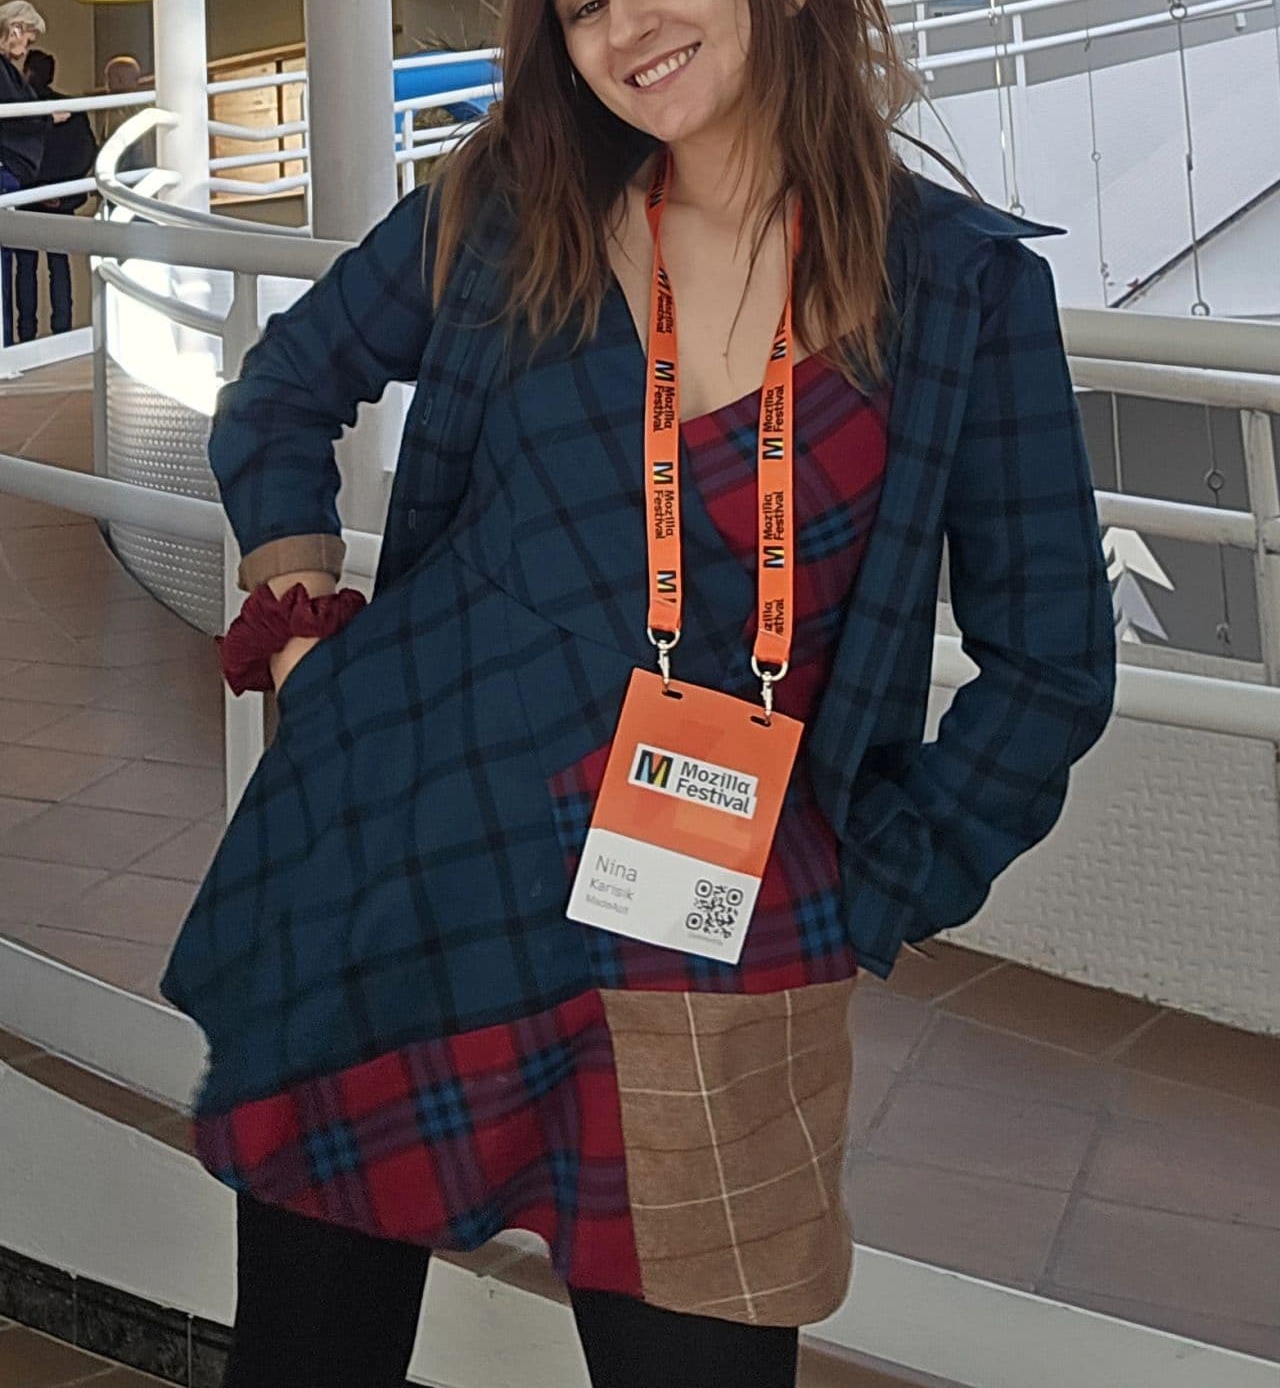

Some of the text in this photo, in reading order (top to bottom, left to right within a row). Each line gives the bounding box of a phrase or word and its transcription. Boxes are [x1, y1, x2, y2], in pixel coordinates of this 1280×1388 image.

[653, 385, 664, 432] Festival
[664, 387, 675, 428] Mozilla
[763, 389, 774, 432] Mozilla
[773, 385, 784, 432] Festival
[654, 490, 665, 539] Festival
[664, 490, 675, 537] Mozilla
[762, 494, 773, 540] Mozilla
[773, 491, 784, 540] Festival
[773, 598, 784, 636] stival
[676, 778, 750, 813] Festival
[680, 761, 750, 796] Mozilla
[595, 855, 638, 882] Nina
